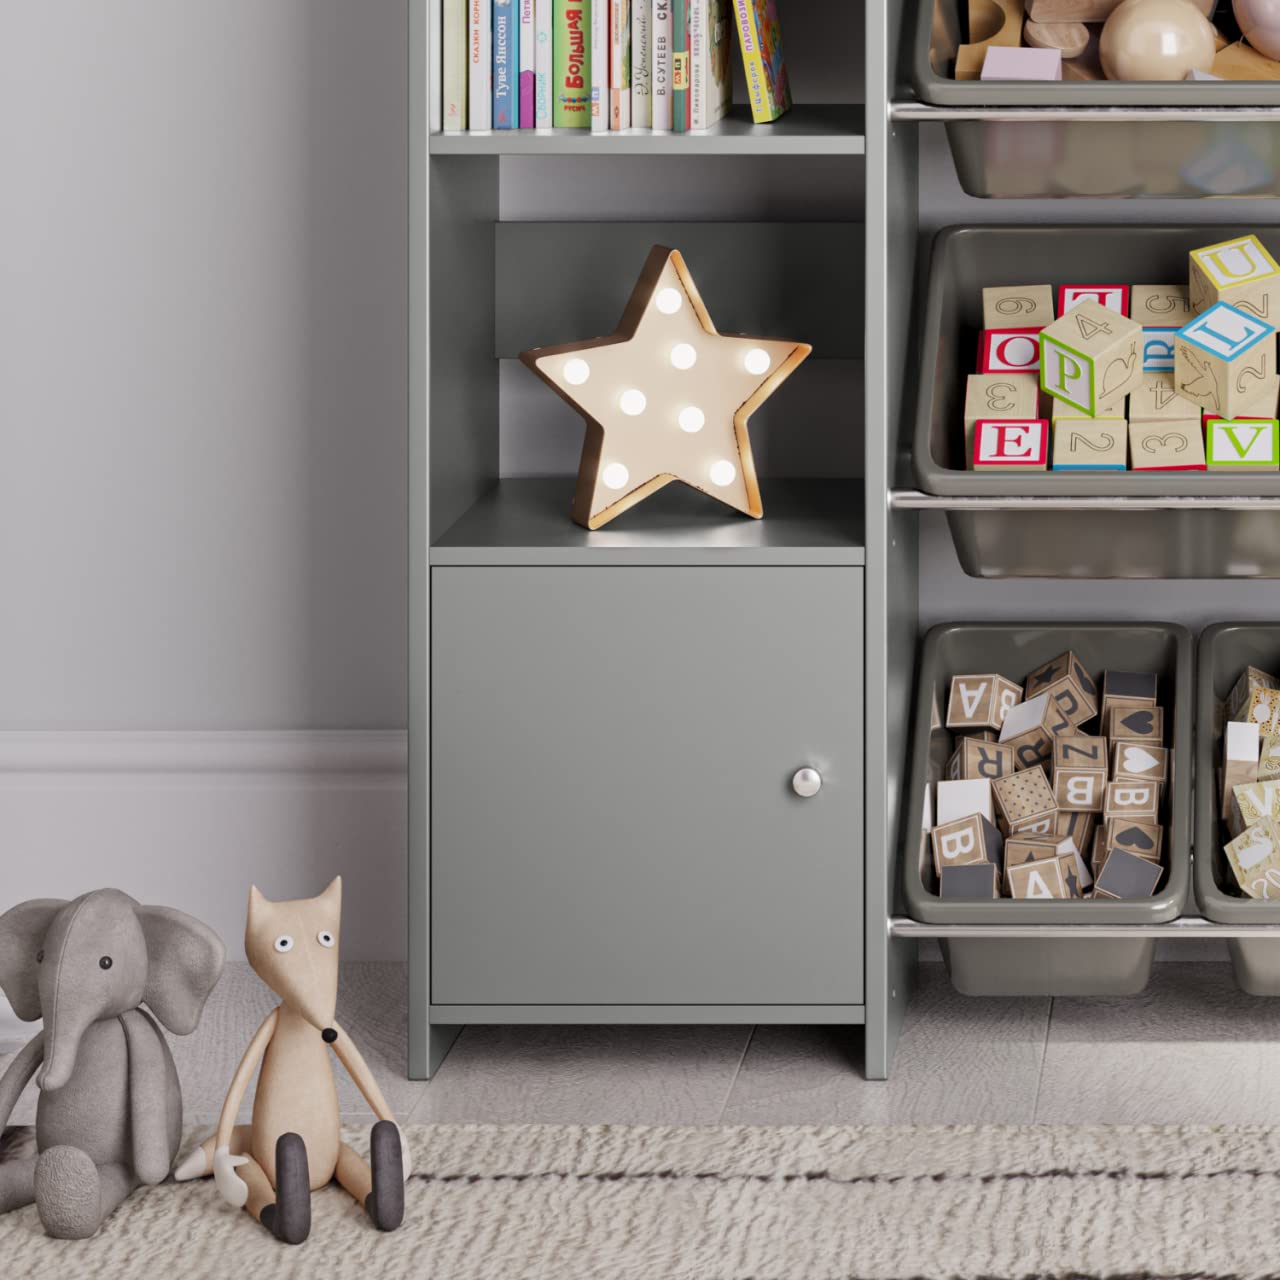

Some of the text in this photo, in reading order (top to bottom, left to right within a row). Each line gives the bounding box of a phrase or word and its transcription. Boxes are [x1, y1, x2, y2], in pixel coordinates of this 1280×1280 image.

[473, 29, 481, 64] СКАЗКИ
[495, 15, 507, 65] Янссон
[656, 35, 668, 84] СУТЕЕВ
[495, 67, 510, 99] Туве
[1202, 243, 1258, 279] U
[1145, 295, 1190, 313] 5
[1075, 314, 1113, 340] 4
[1193, 321, 1256, 351] L
[996, 336, 1040, 367] O
[1054, 349, 1082, 394] P
[1236, 353, 1266, 393] 2
[989, 426, 1033, 457] E
[1070, 432, 1115, 452] 2
[1141, 432, 1188, 453] 3
[1217, 426, 1268, 459] V
[958, 682, 987, 718] A
[1016, 738, 1046, 769] R
[1066, 776, 1095, 805] B
[1114, 787, 1149, 806] B
[940, 826, 975, 859] B
